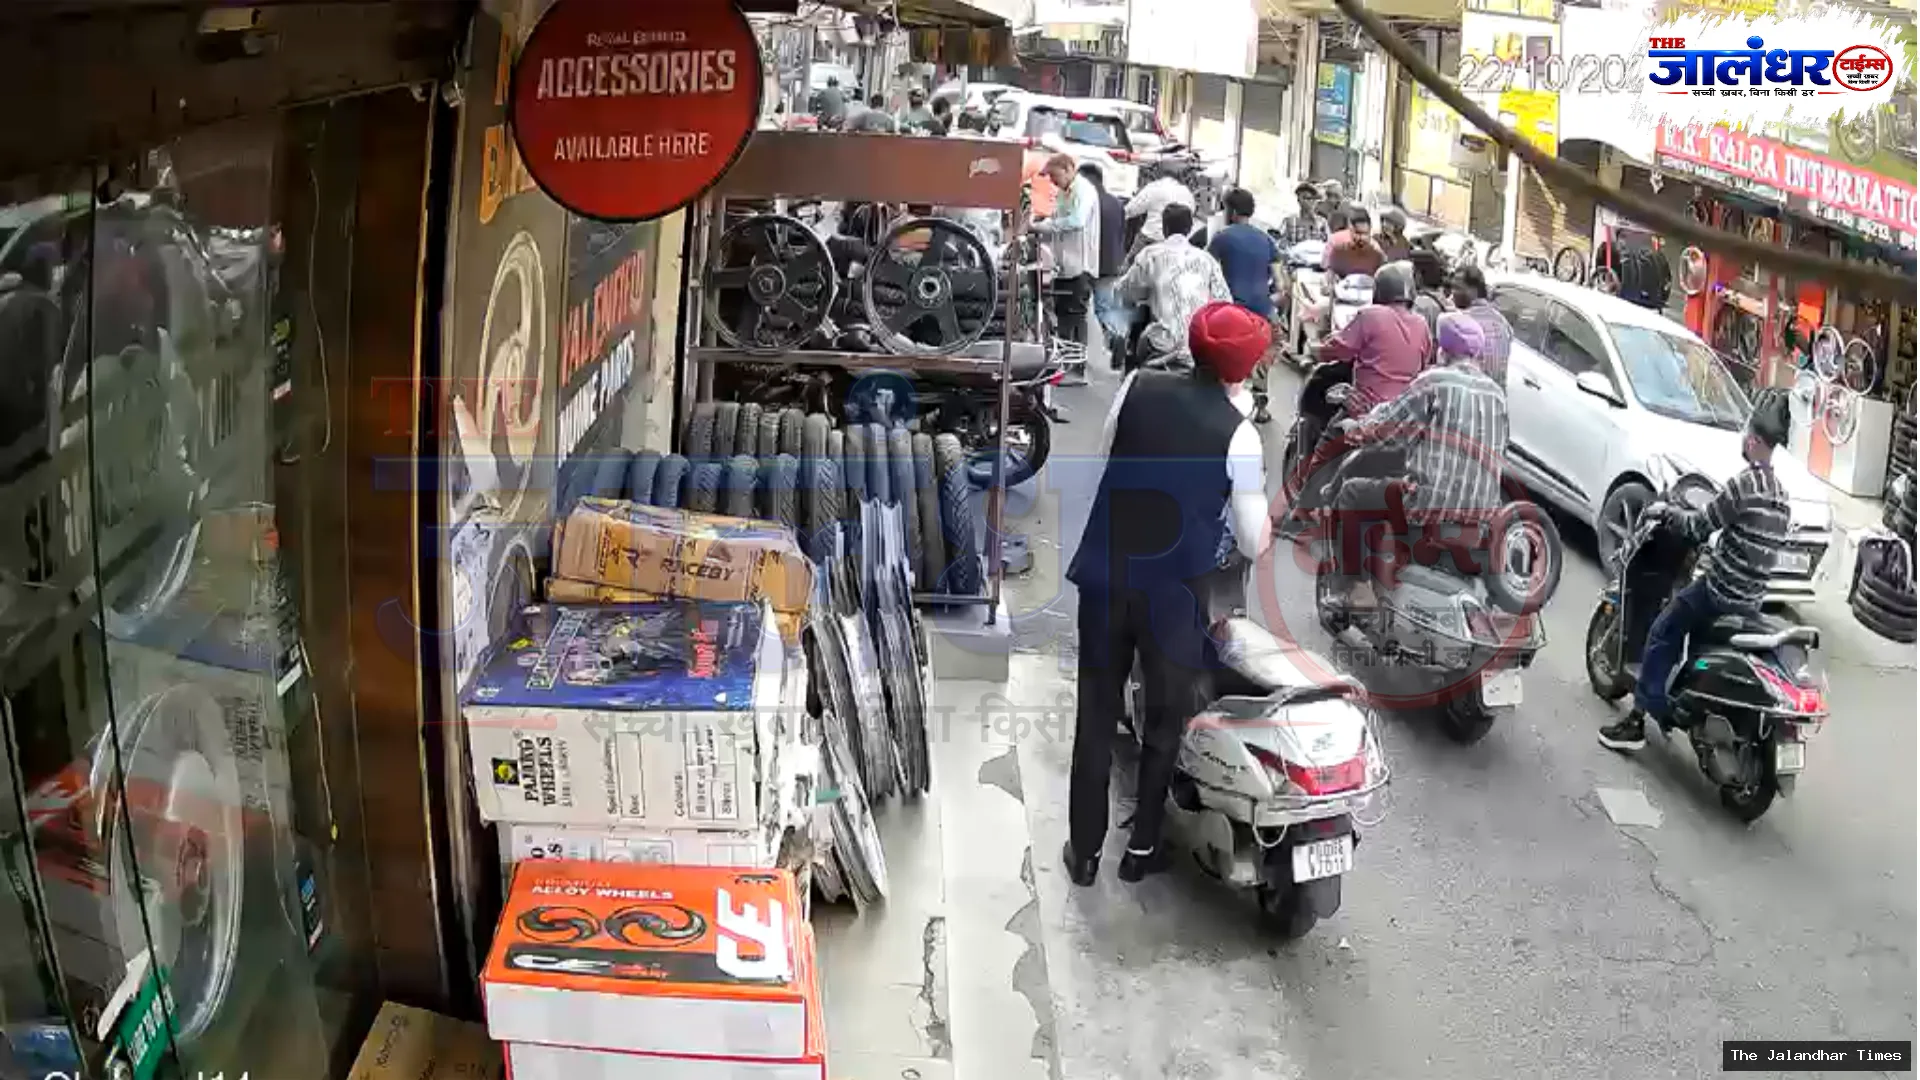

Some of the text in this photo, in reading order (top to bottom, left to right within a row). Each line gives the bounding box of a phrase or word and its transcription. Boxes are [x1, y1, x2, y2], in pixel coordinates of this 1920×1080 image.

[537, 49, 737, 100] ACCESSORIES
[554, 131, 712, 162] AVAILABLE HERE
[1710, 132, 1779, 180] KALRA
[661, 557, 736, 581] RACEBY
[536, 736, 557, 807] WHEELS
[532, 885, 673, 899] ALLOY WHEELS
